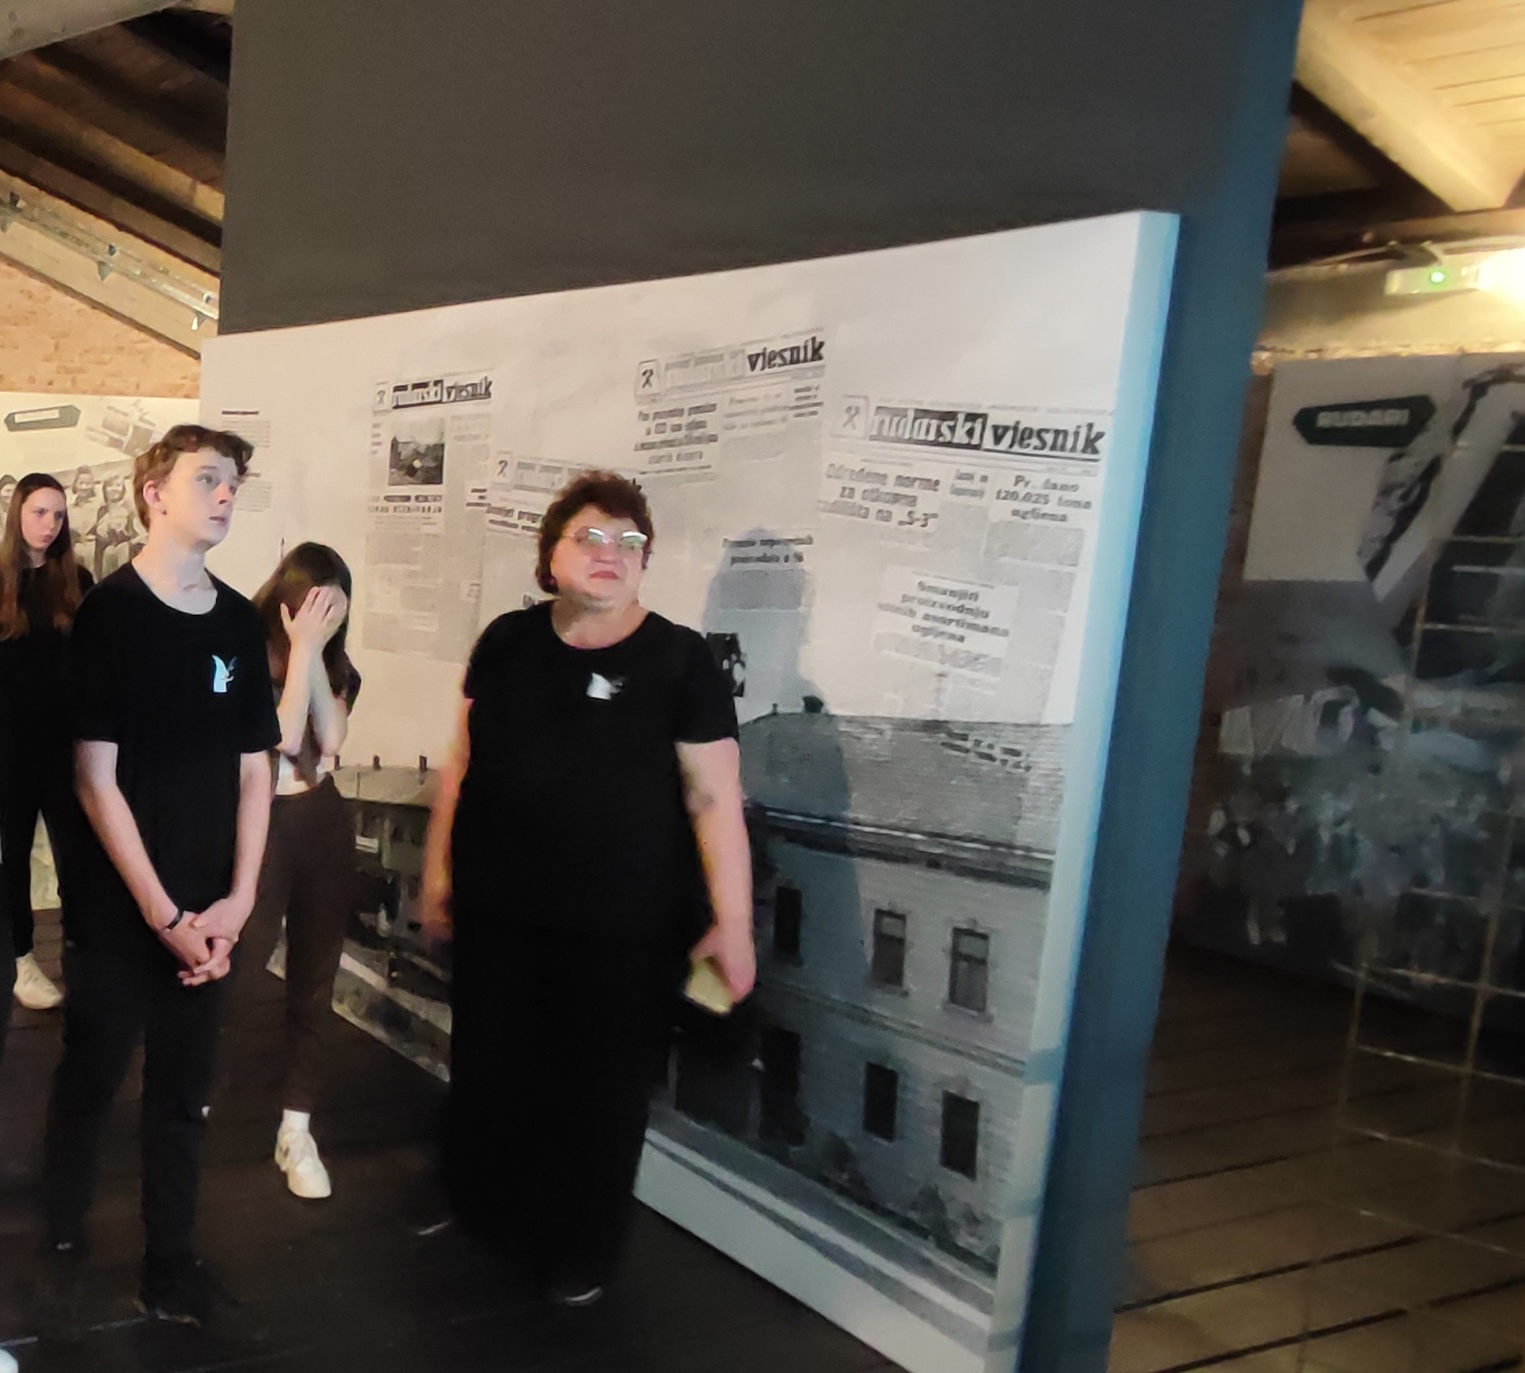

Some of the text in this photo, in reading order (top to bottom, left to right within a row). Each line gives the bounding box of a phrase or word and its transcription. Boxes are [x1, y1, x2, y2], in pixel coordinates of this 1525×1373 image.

[747, 336, 825, 372] vjesnik
[873, 408, 1104, 455] rudarski vjesnik
